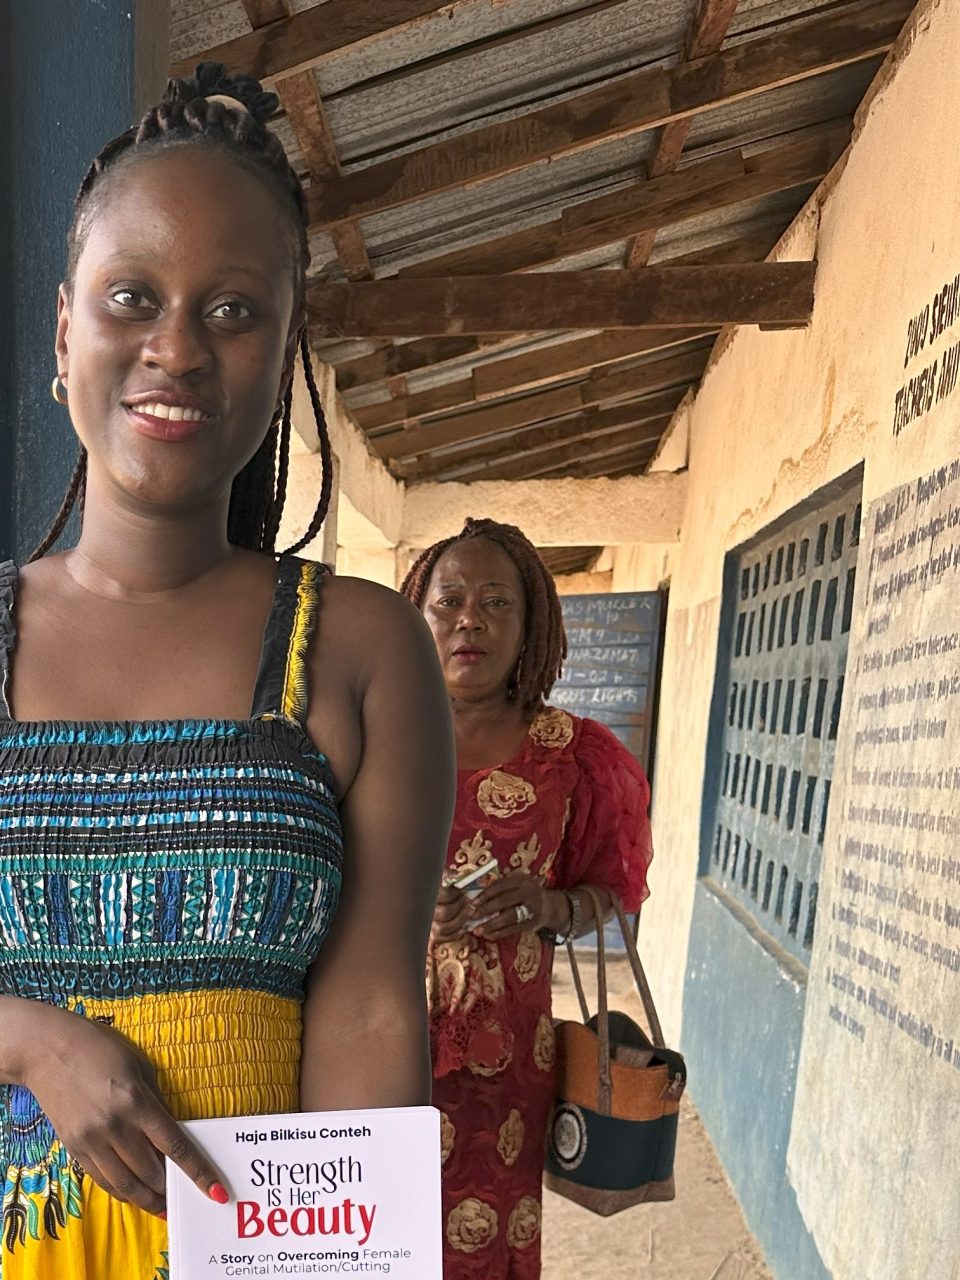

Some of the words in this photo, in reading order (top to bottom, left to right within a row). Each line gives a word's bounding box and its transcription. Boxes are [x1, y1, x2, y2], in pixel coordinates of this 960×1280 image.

[893, 360, 937, 437] TEACHERS
[235, 1131, 268, 1145] Haja
[270, 1128, 316, 1142] Bilkisu
[319, 1126, 372, 1139] Conteh
[250, 1155, 362, 1194] Strength
[290, 1187, 321, 1206] Her
[236, 1198, 377, 1246] Beauty
[208, 1255, 218, 1265] A
[220, 1253, 255, 1265] Story
[257, 1253, 274, 1262] on
[277, 1249, 359, 1263] Overcoming
[362, 1248, 412, 1259] Female
[225, 1264, 270, 1276] Genital
[273, 1260, 391, 1275] Mutilation/Cutting
